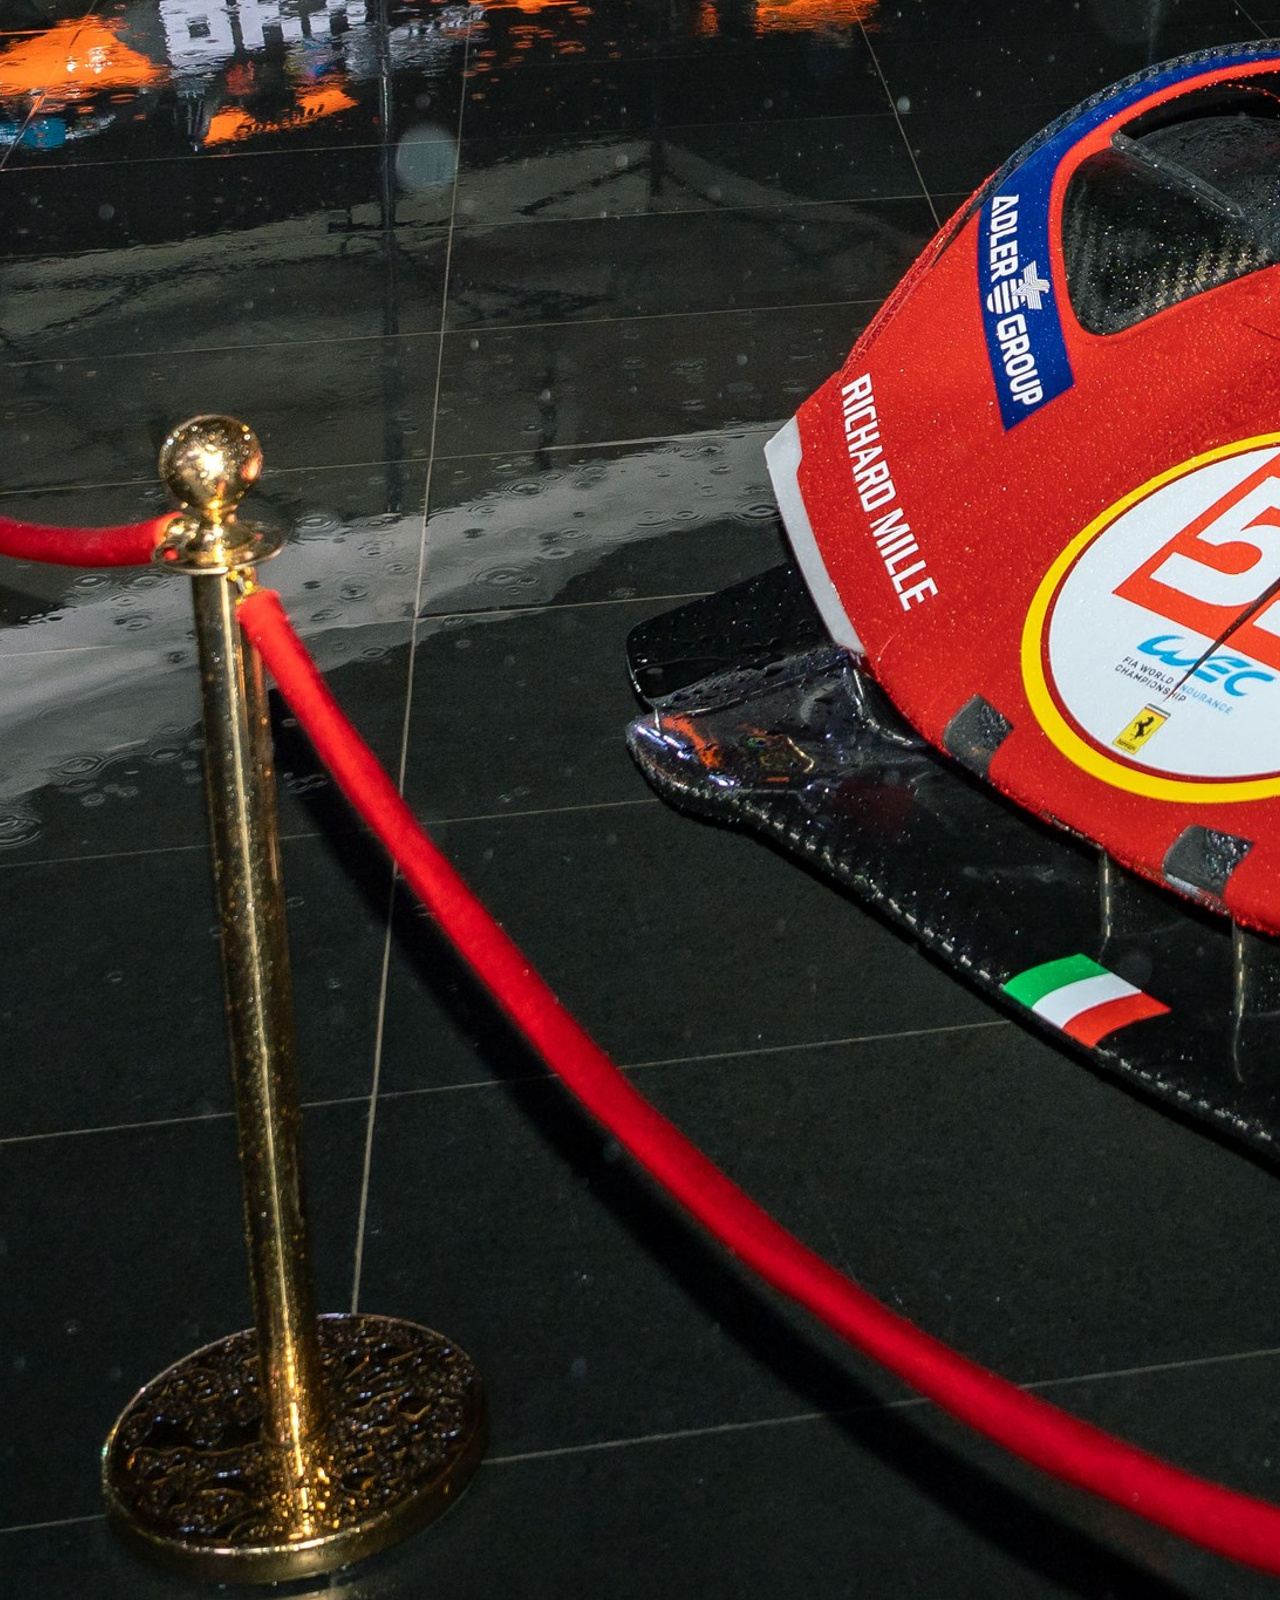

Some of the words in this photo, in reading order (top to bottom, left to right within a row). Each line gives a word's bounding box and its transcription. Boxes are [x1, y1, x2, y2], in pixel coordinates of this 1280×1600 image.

[989, 194, 1020, 283] ADLER
[996, 313, 1043, 406] GROUP
[841, 373, 897, 513] RICHARD
[870, 506, 940, 612] MILLE
[1114, 663, 1188, 703] CHAMPIONSHIP
[1122, 655, 1138, 669] FIA
[1139, 664, 1175, 685] WORLD
[1176, 682, 1235, 715] NDURANCE
[1136, 634, 1276, 697] WEC
